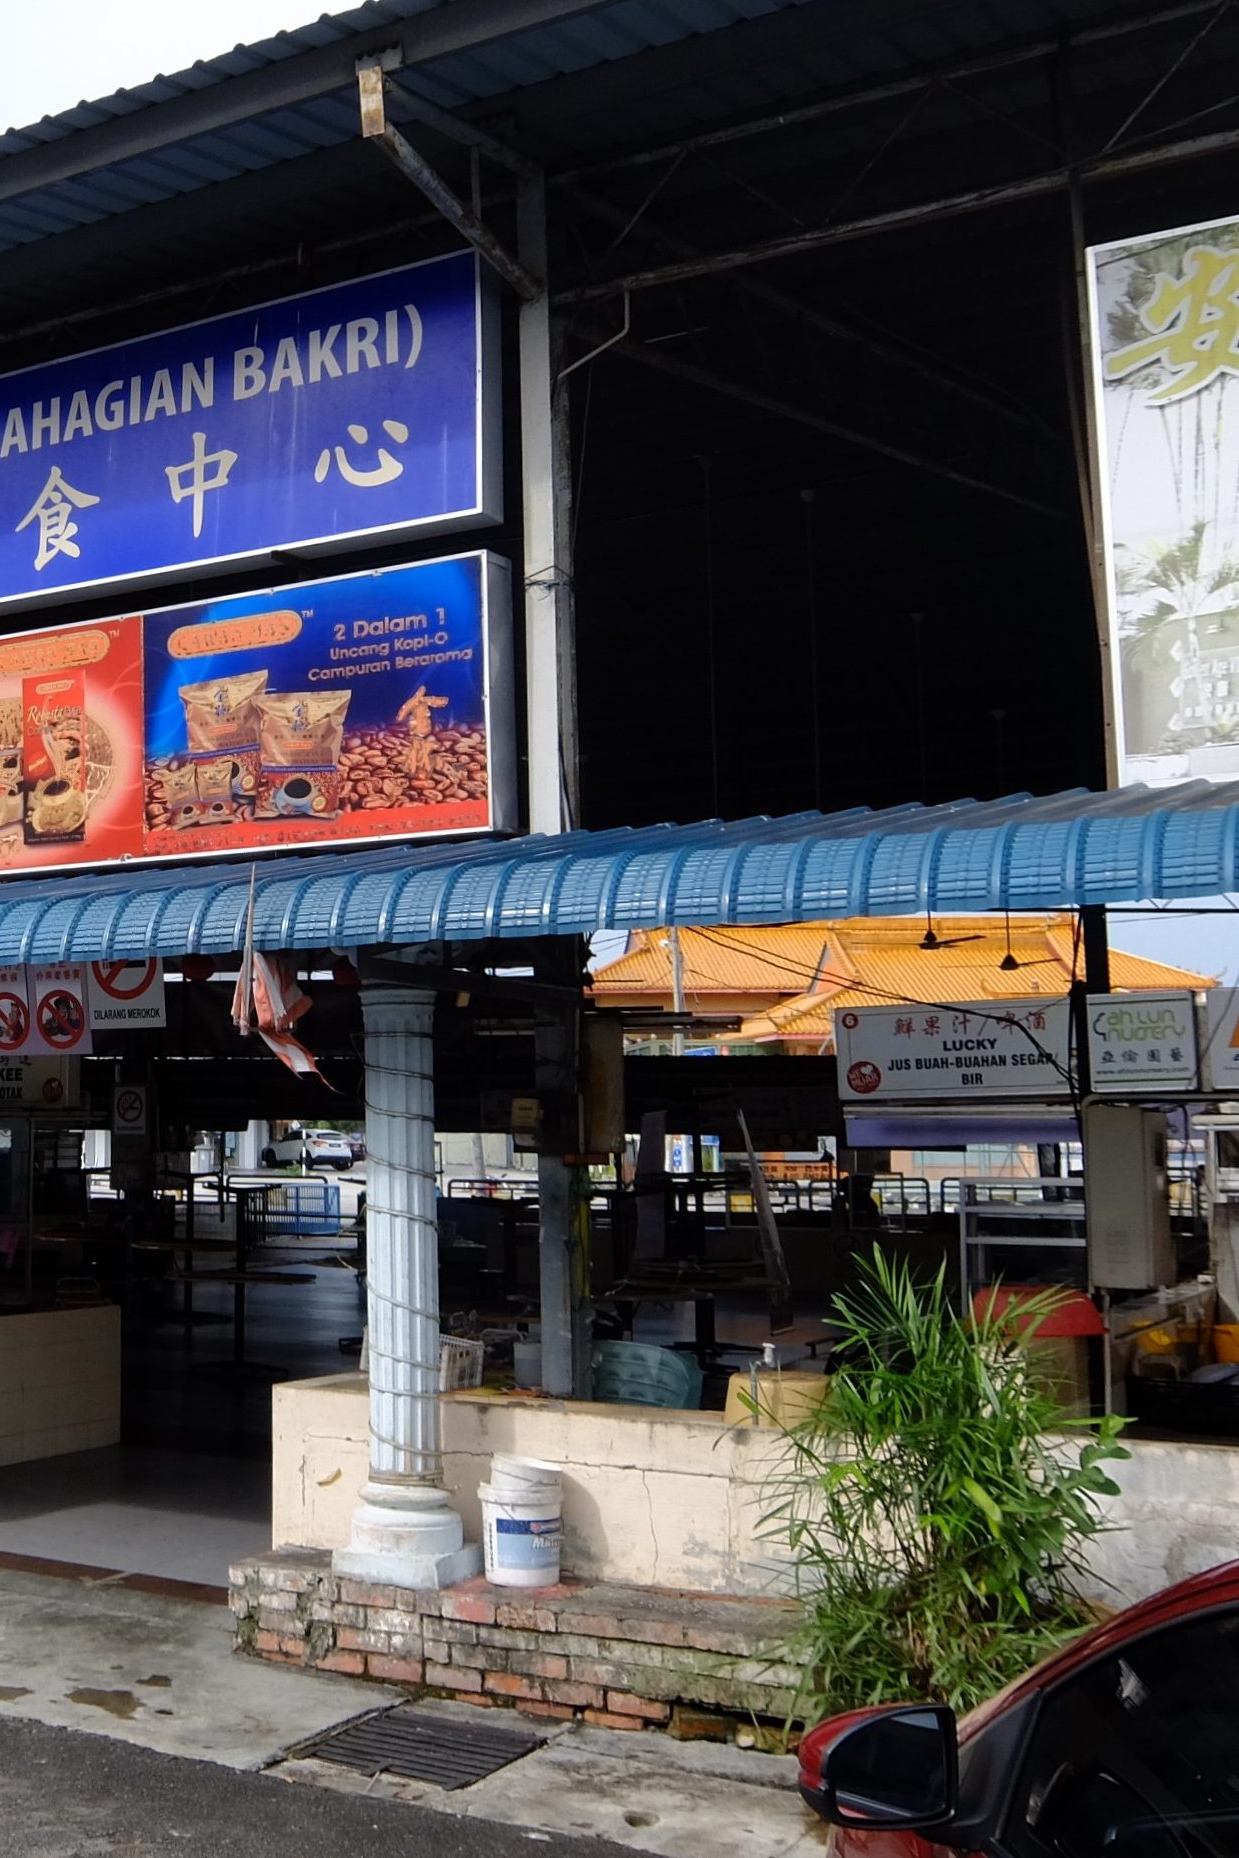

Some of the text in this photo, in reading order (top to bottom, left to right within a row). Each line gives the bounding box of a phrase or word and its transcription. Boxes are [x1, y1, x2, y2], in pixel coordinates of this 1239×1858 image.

[233, 303, 422, 400] BAKRI)
[334, 608, 446, 641] 2 Dalam 1
[330, 632, 448, 662] Uncang Kopi-O
[309, 647, 473, 682] Campuran Beraroma
[94, 1008, 160, 1020] DILARANG MEROKOK
[943, 1038, 998, 1052] LUCKY
[888, 1058, 911, 1071] JUS
[916, 1054, 1008, 1070] BUAH-BUAHAN
[962, 1073, 984, 1085] BIR
[0, 1086, 23, 1099] OTAK
